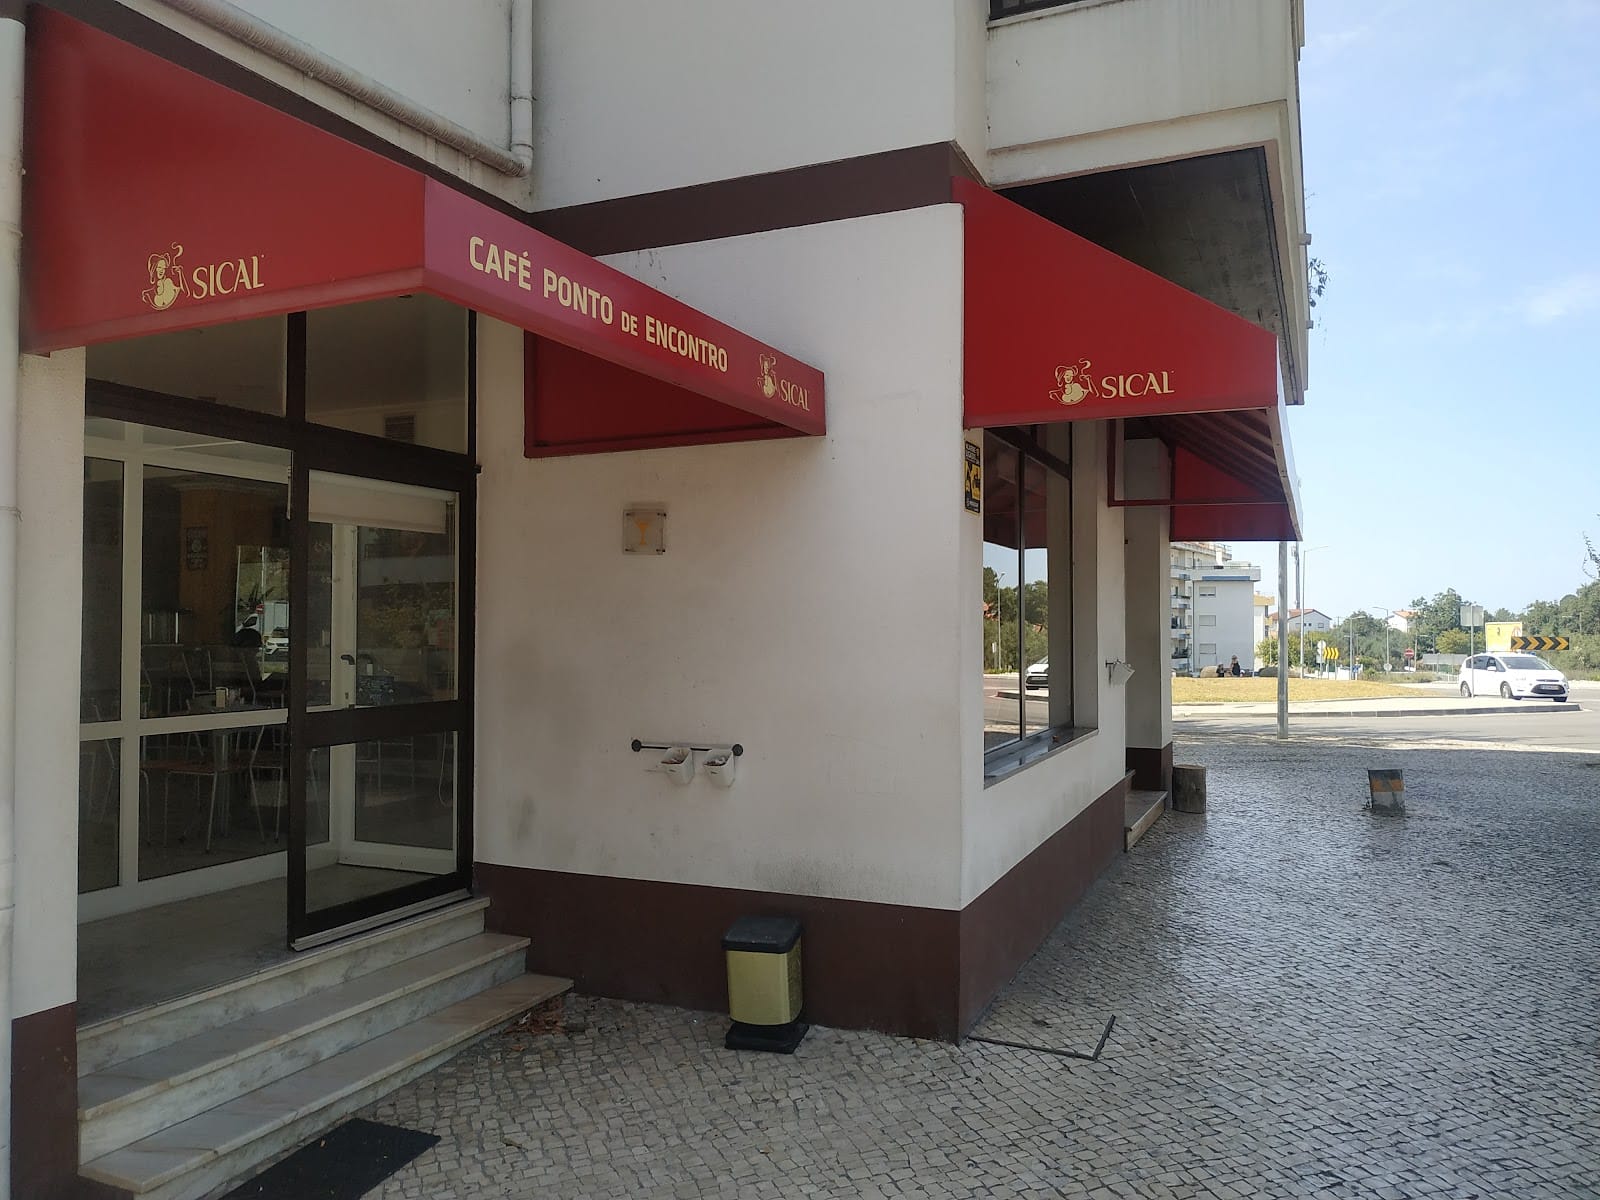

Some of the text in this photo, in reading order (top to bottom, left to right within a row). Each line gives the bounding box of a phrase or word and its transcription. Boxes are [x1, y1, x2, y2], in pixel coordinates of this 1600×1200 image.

[192, 255, 265, 300] SICAL
[469, 236, 729, 373] CAFÉ PONTO DE ENCONTRO
[780, 378, 811, 411] SICAL
[1101, 370, 1176, 399] SICAL
